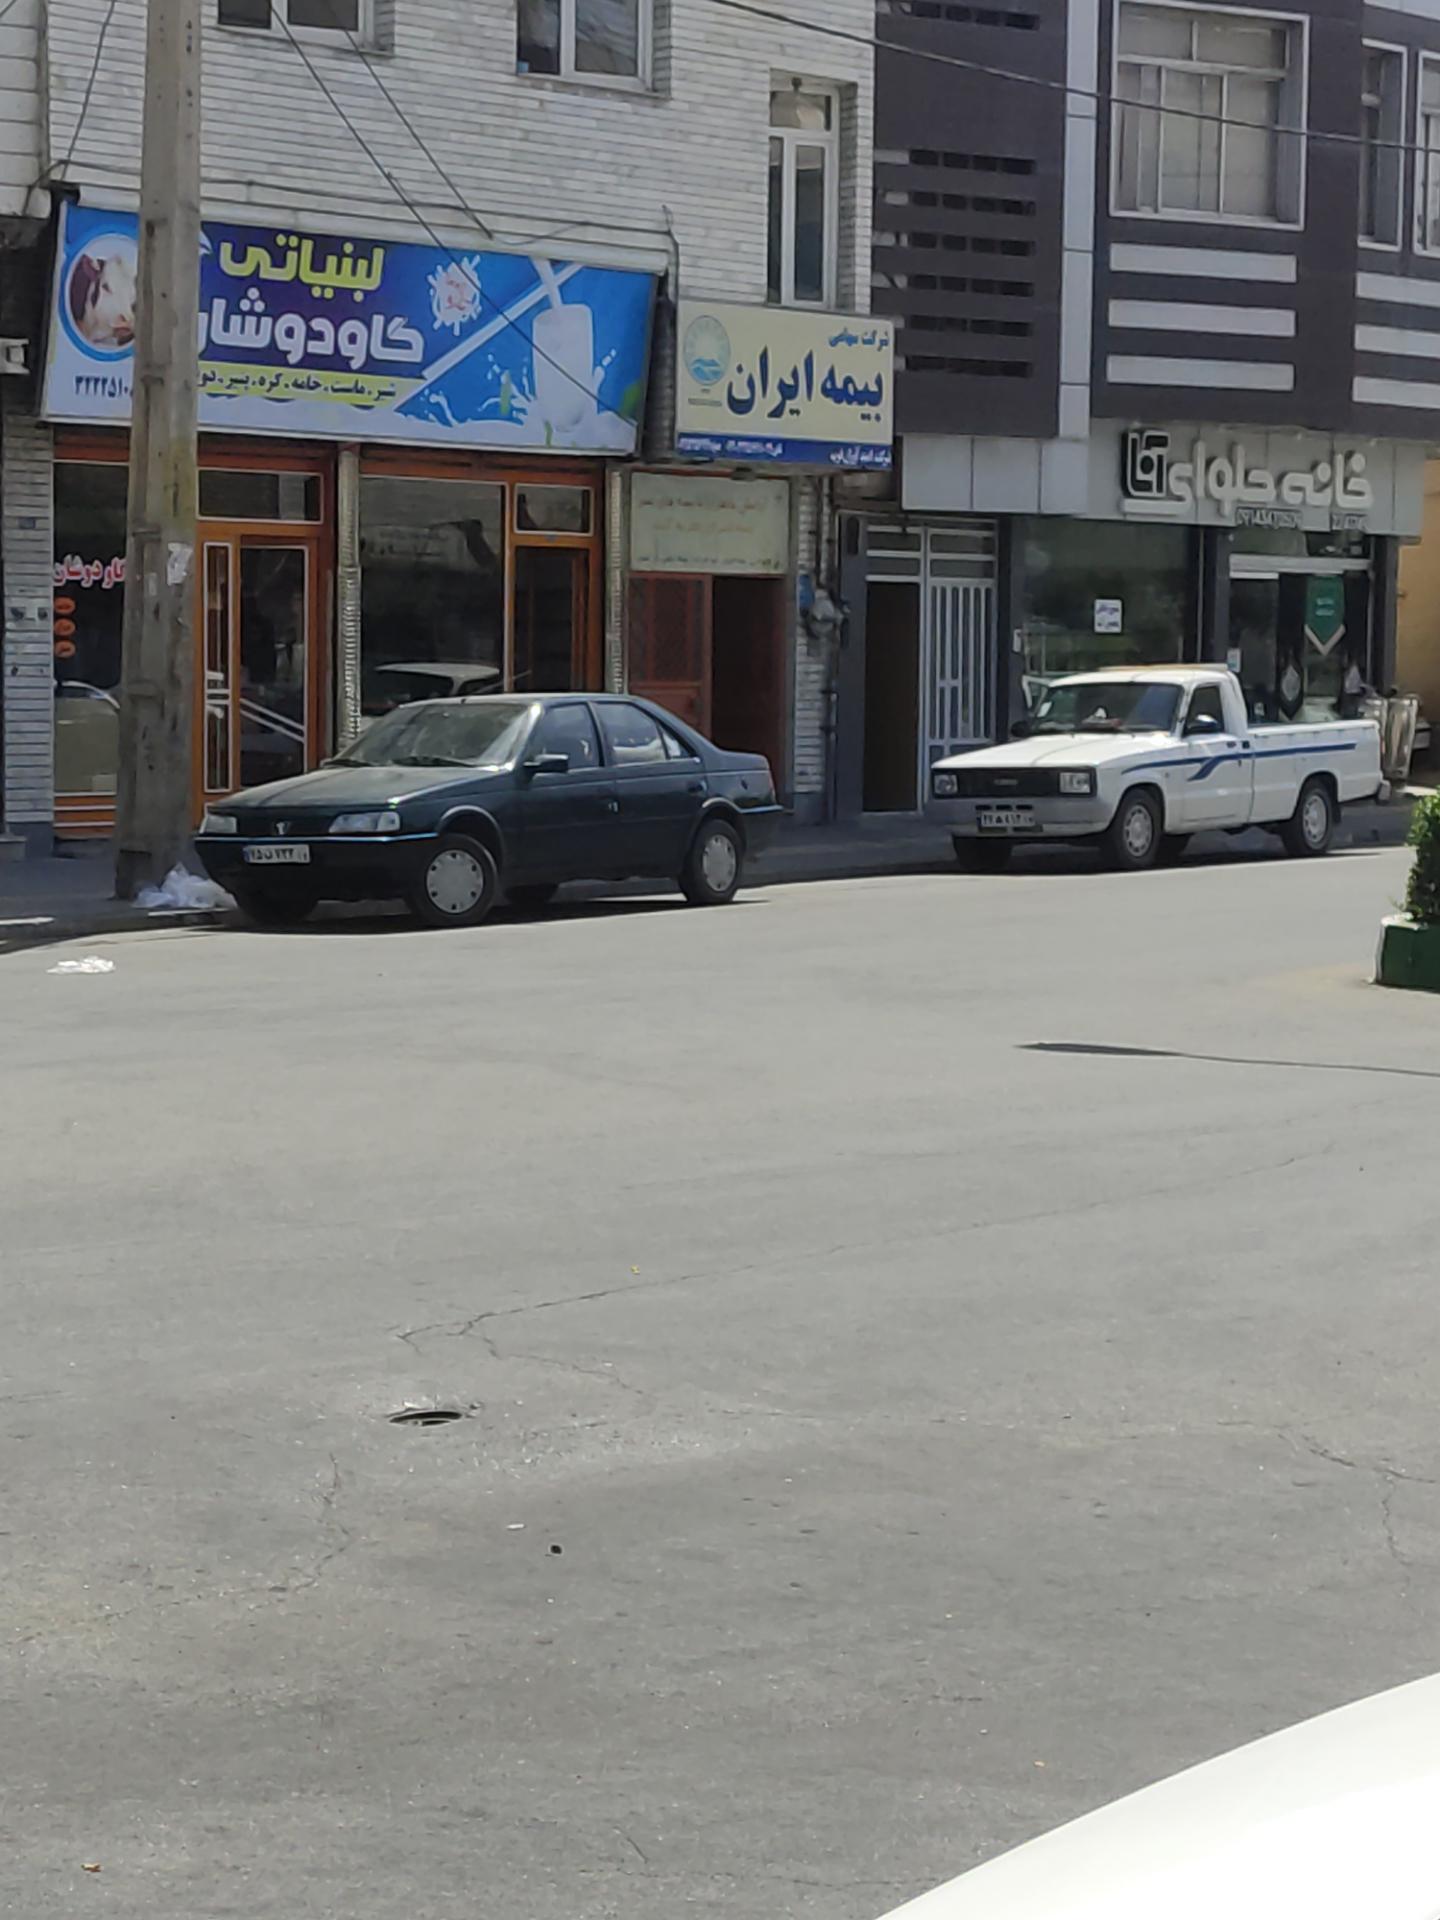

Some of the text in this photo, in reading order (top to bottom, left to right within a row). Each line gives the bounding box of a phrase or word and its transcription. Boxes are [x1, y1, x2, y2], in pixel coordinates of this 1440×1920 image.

[220, 234, 384, 302] لبنیاتی
[197, 370, 216, 387] دو
[727, 344, 883, 423] بیمه ایران
[1123, 440, 1277, 518] حلوای
[1281, 452, 1375, 509] خانه
